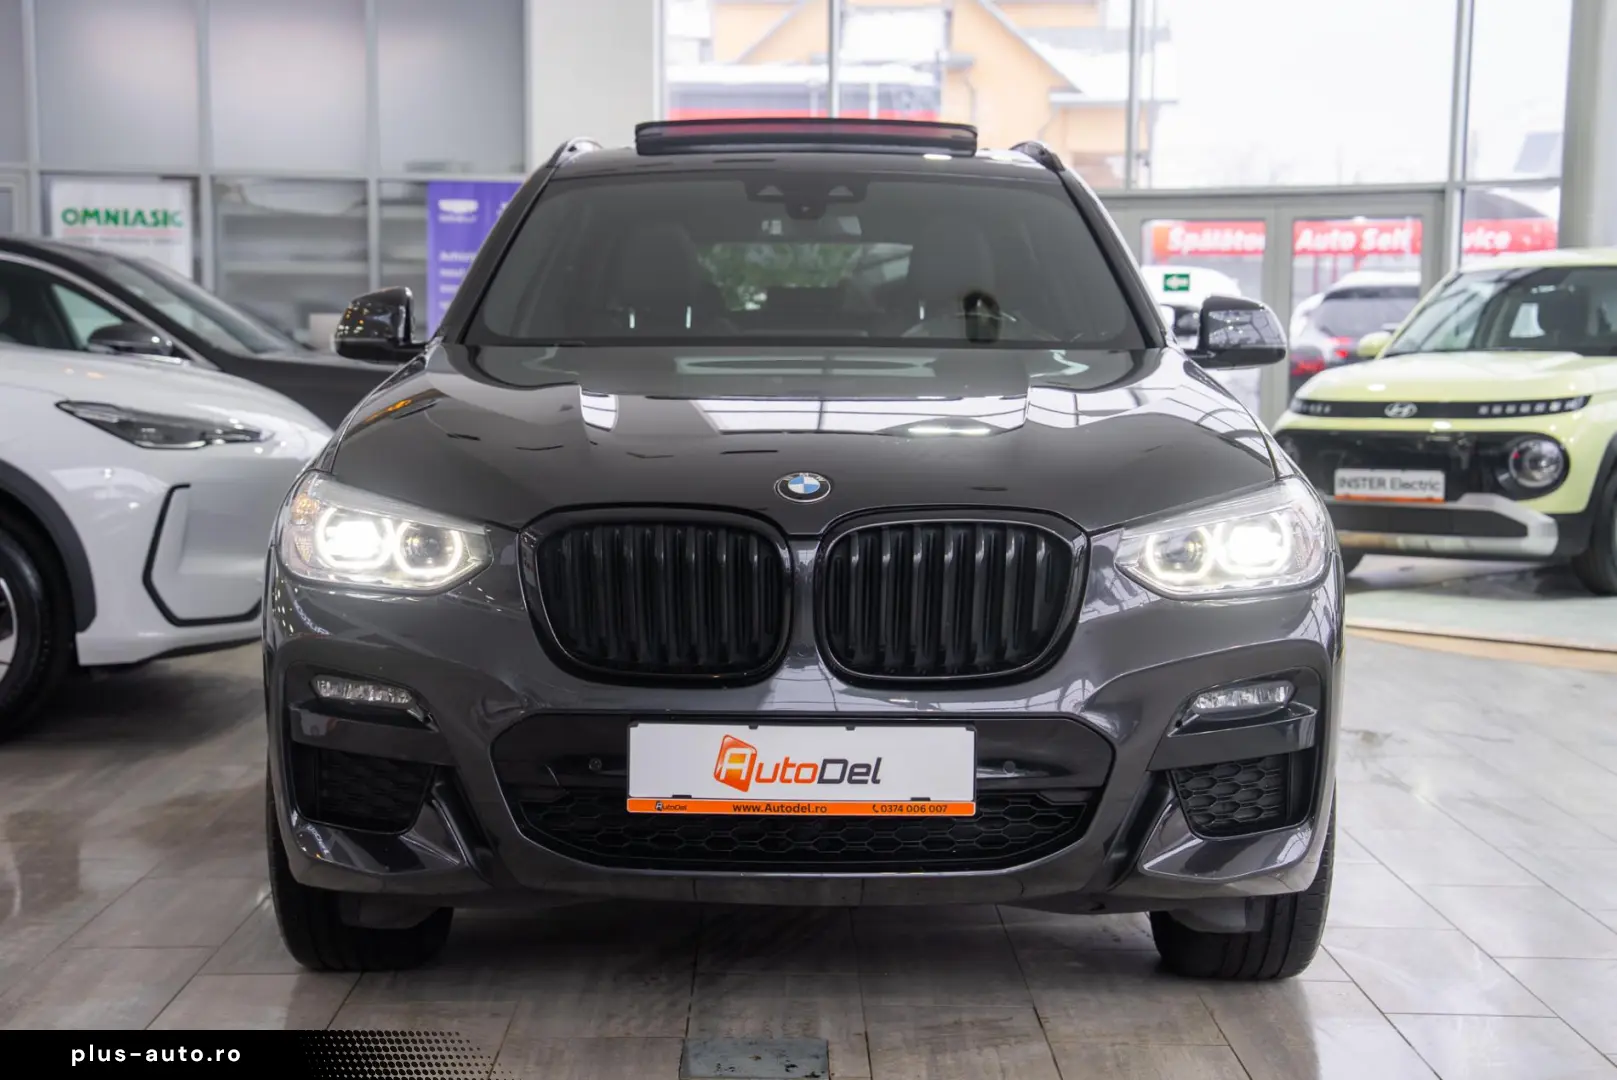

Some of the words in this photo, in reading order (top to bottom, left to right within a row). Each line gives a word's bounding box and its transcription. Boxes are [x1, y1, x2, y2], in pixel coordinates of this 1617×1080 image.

[1295, 228, 1356, 250] Auto
[1338, 476, 1387, 490] INSTER
[1389, 477, 1441, 491] Electric
[717, 744, 882, 787] AutoDel
[733, 803, 828, 814] www.Autodel.ro
[880, 804, 903, 813] 0374
[906, 804, 926, 813] 006
[928, 804, 948, 813] 007
